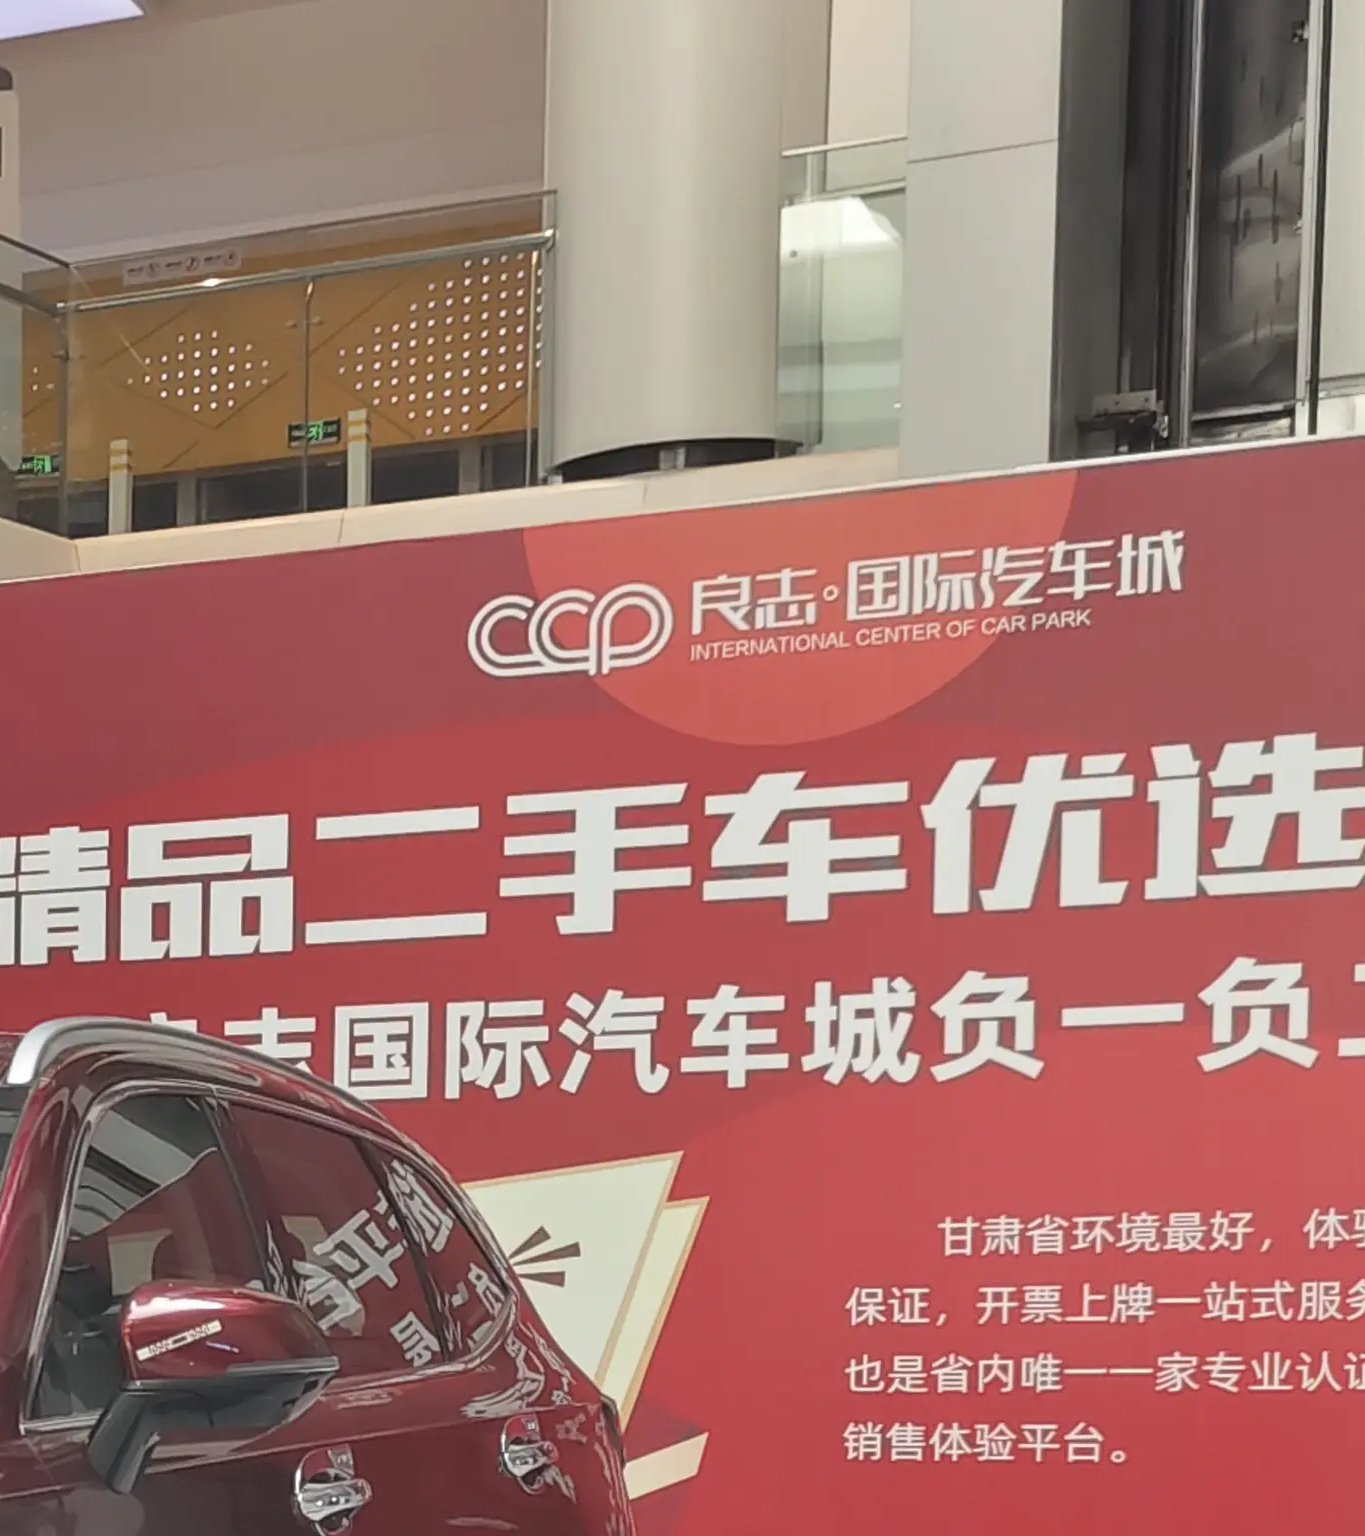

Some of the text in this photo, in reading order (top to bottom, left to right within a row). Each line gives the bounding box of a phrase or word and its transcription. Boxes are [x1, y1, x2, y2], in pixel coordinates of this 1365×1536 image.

[689, 608, 1092, 662] INTERNATIONAL CENTER OF CAR PARK
[842, 1421, 1127, 1465] 销售体验平台。
